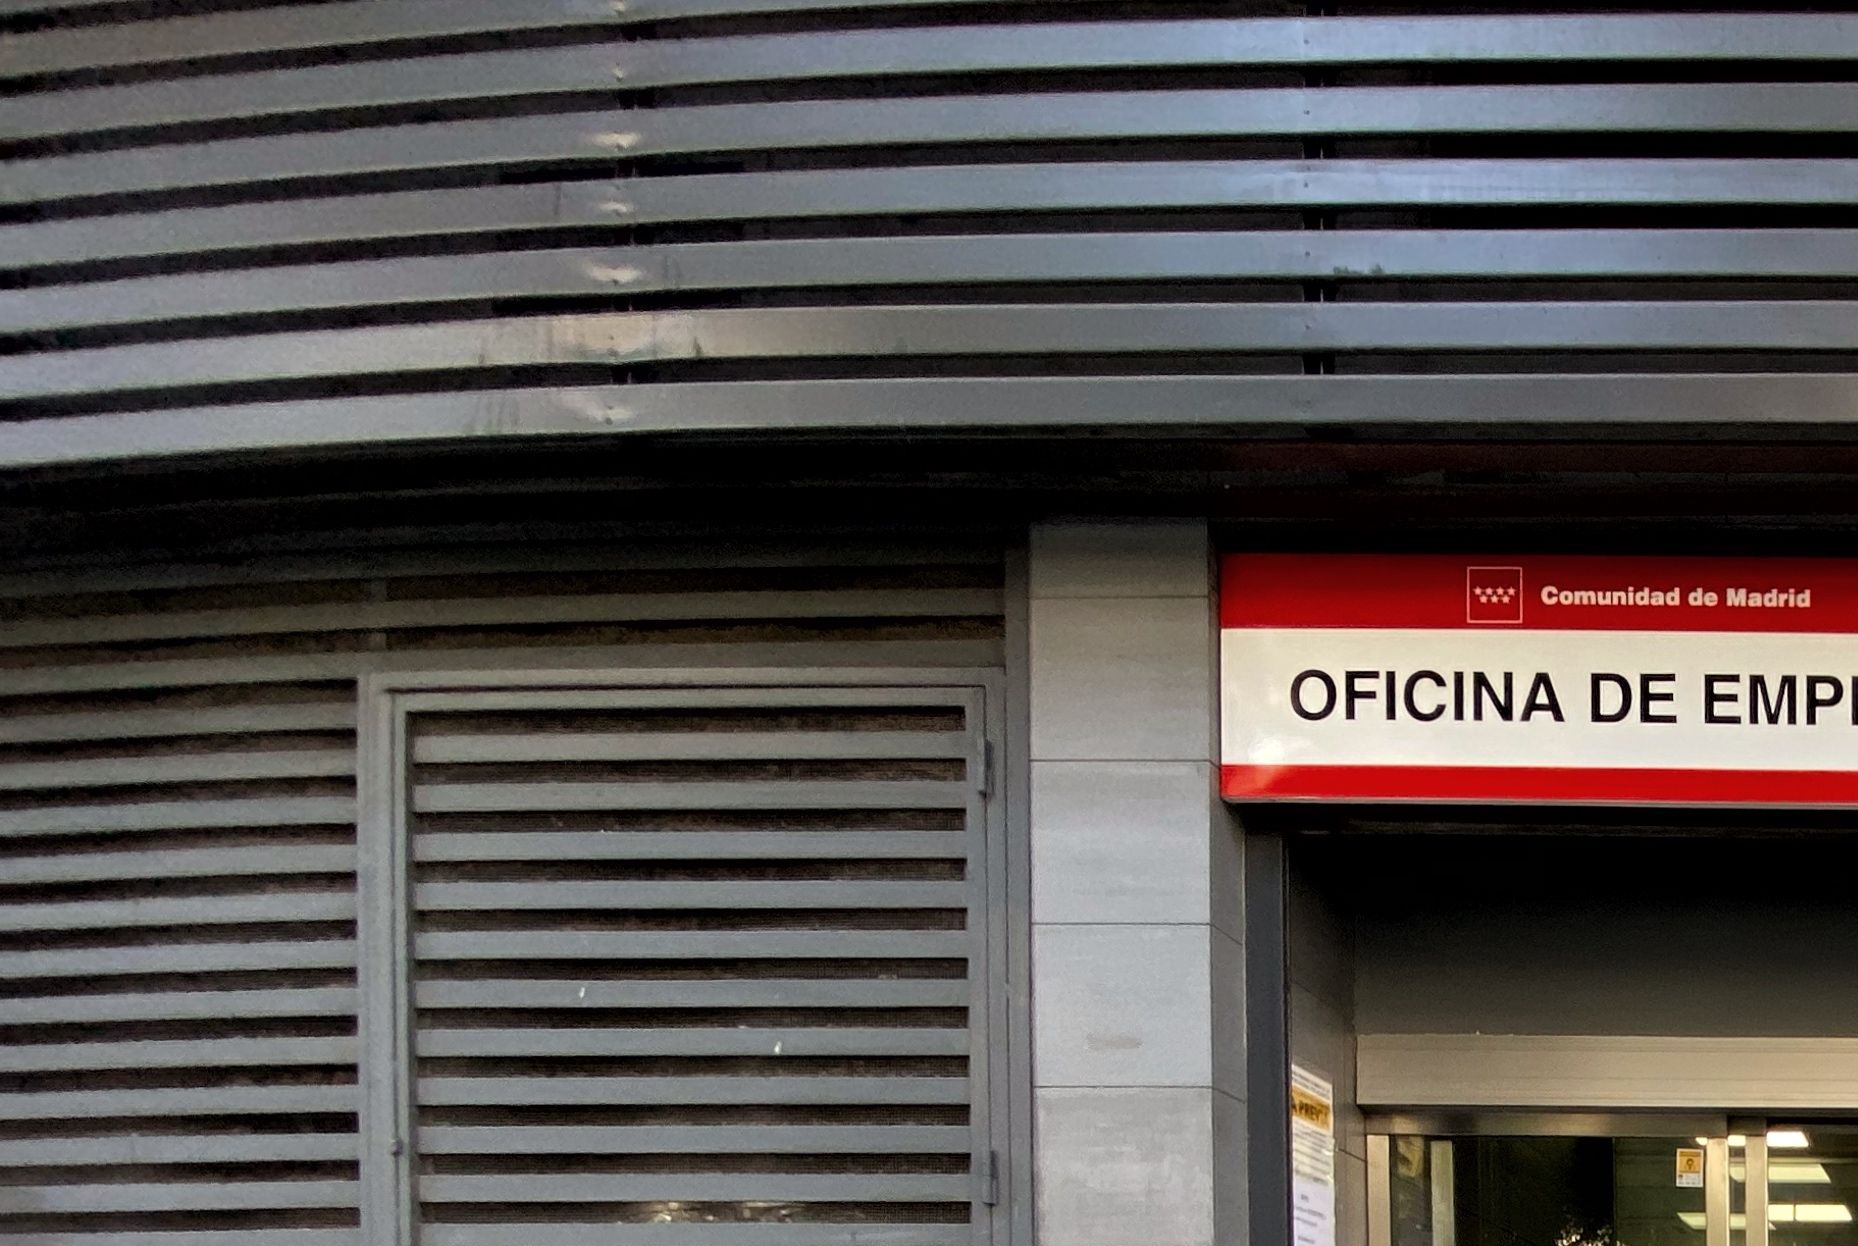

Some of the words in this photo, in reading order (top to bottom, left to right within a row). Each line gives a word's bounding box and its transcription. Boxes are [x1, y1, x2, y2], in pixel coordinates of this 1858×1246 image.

[1541, 585, 1679, 608] Comunidad
[1689, 586, 1719, 608] de
[1727, 587, 1811, 609] Madrid
[1290, 668, 1565, 724] OFICINA
[1590, 672, 1678, 724] DE
